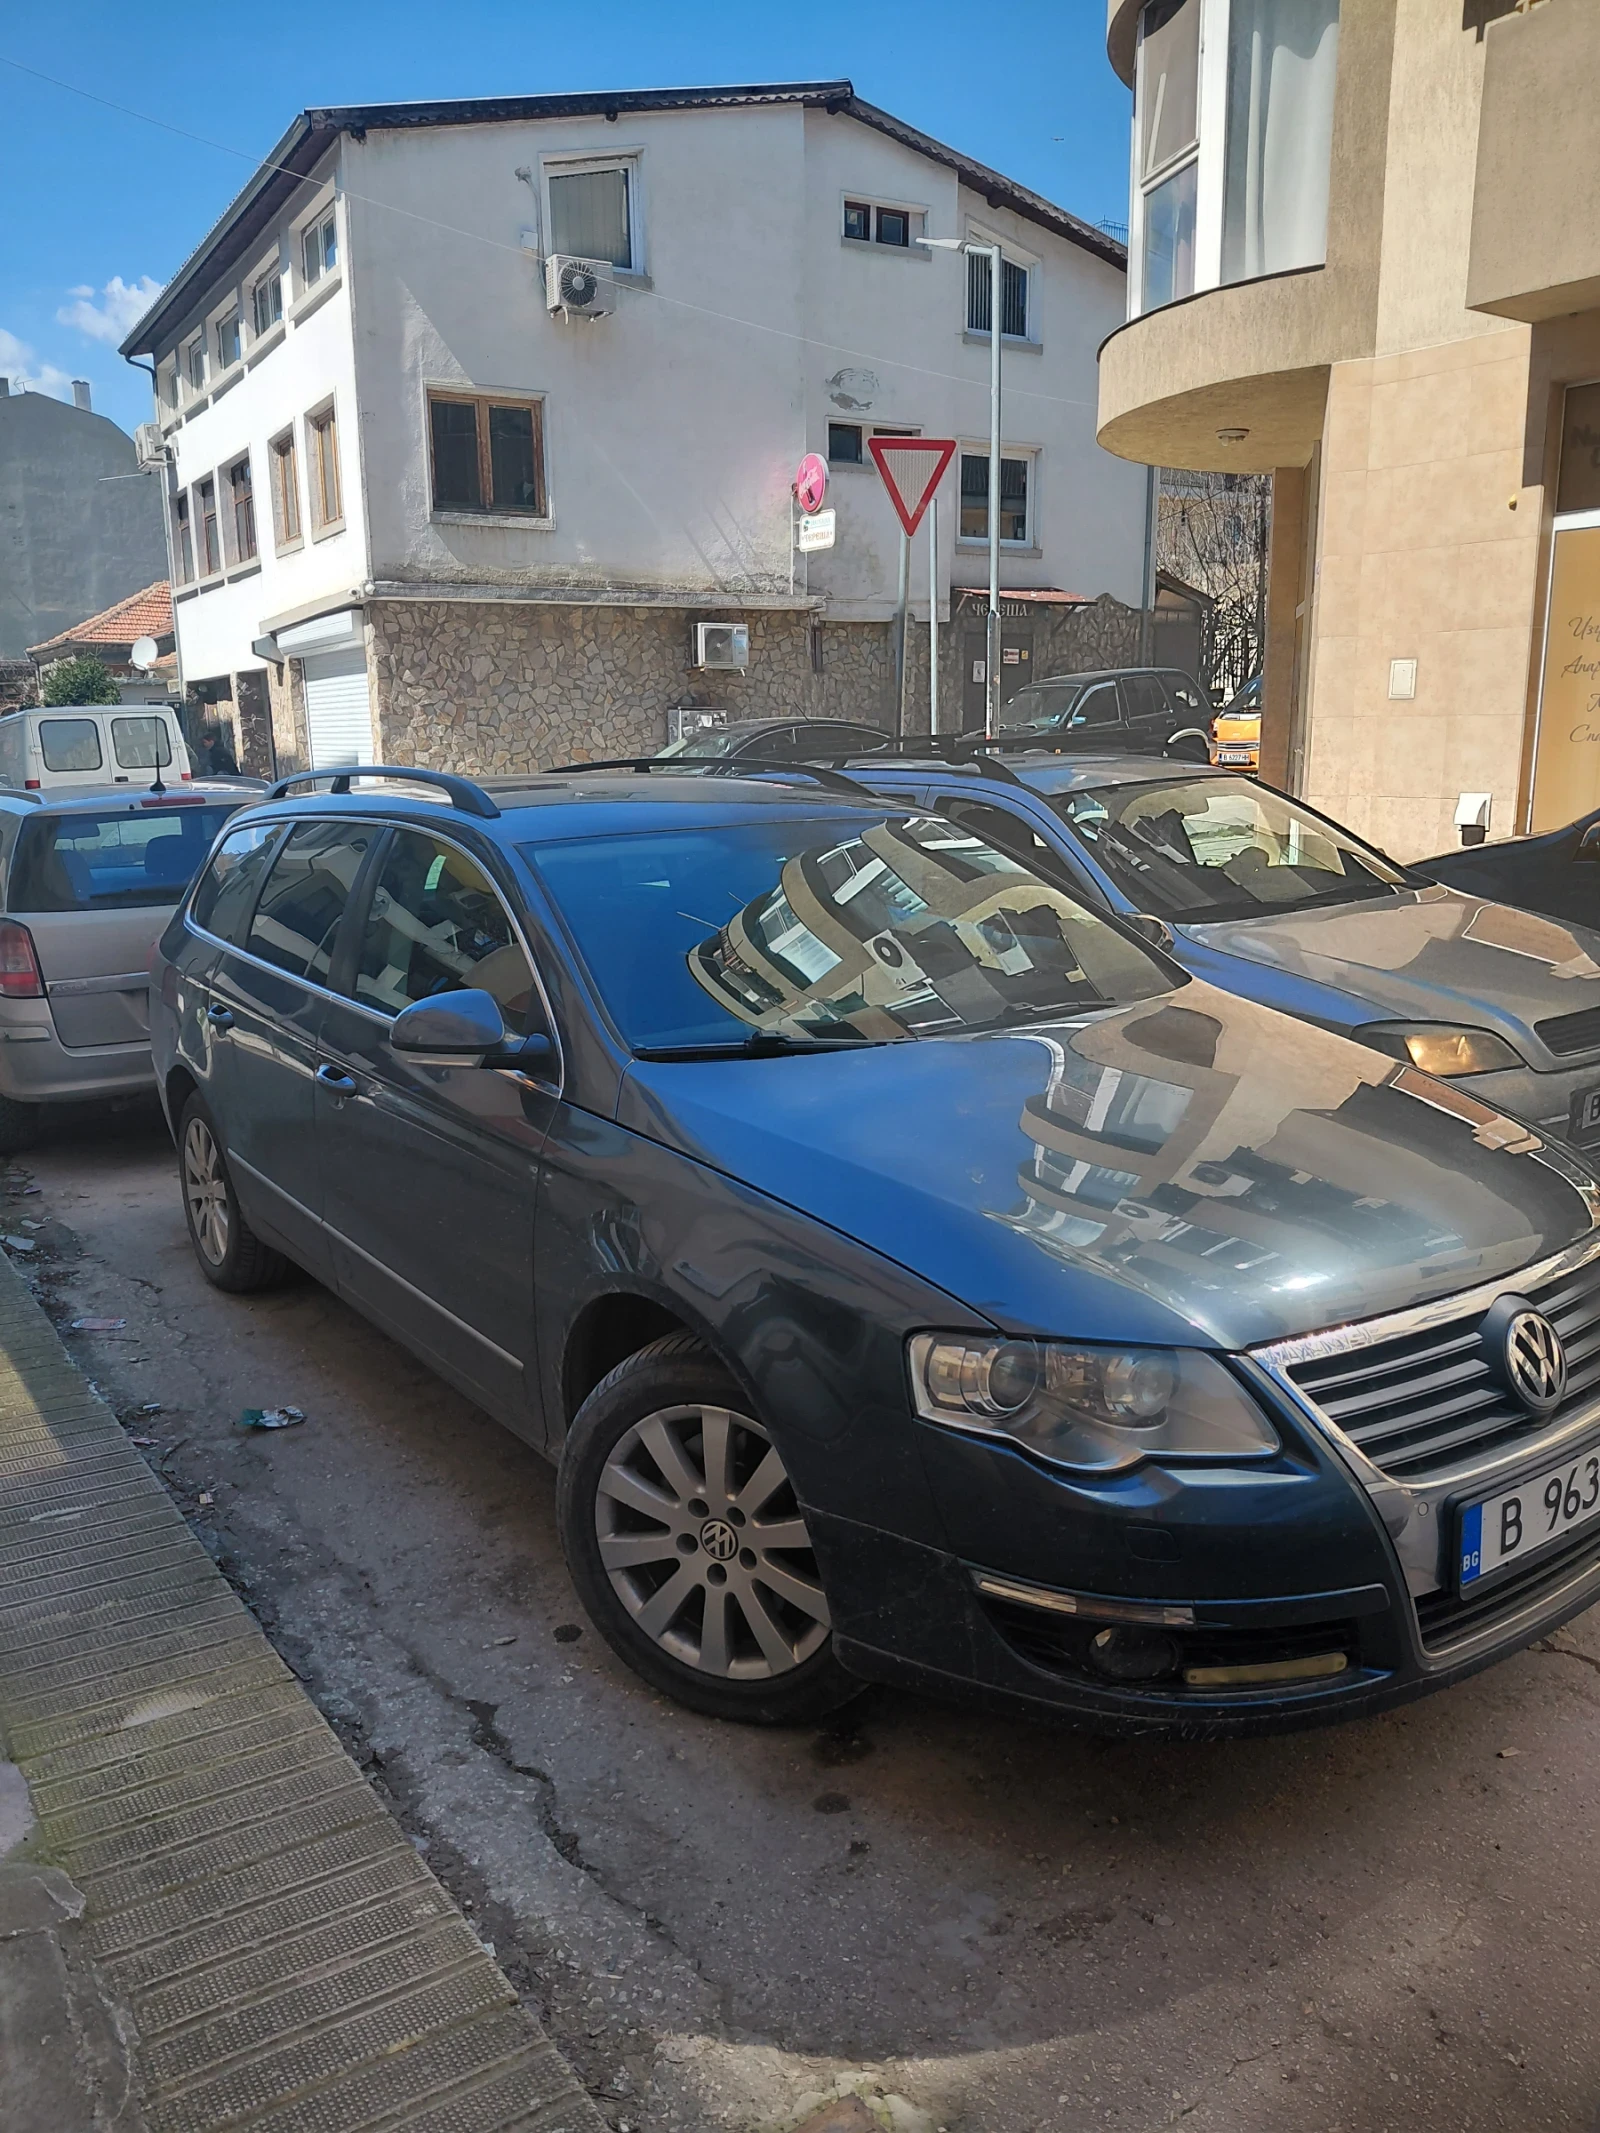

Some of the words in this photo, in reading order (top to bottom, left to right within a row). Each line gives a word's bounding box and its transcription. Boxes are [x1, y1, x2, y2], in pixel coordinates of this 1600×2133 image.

[972, 603, 1028, 617] ЧЕЕША
[1500, 1497, 1523, 1556] B
[1544, 1456, 1600, 1532] 963
[1462, 1551, 1479, 1572] BG
